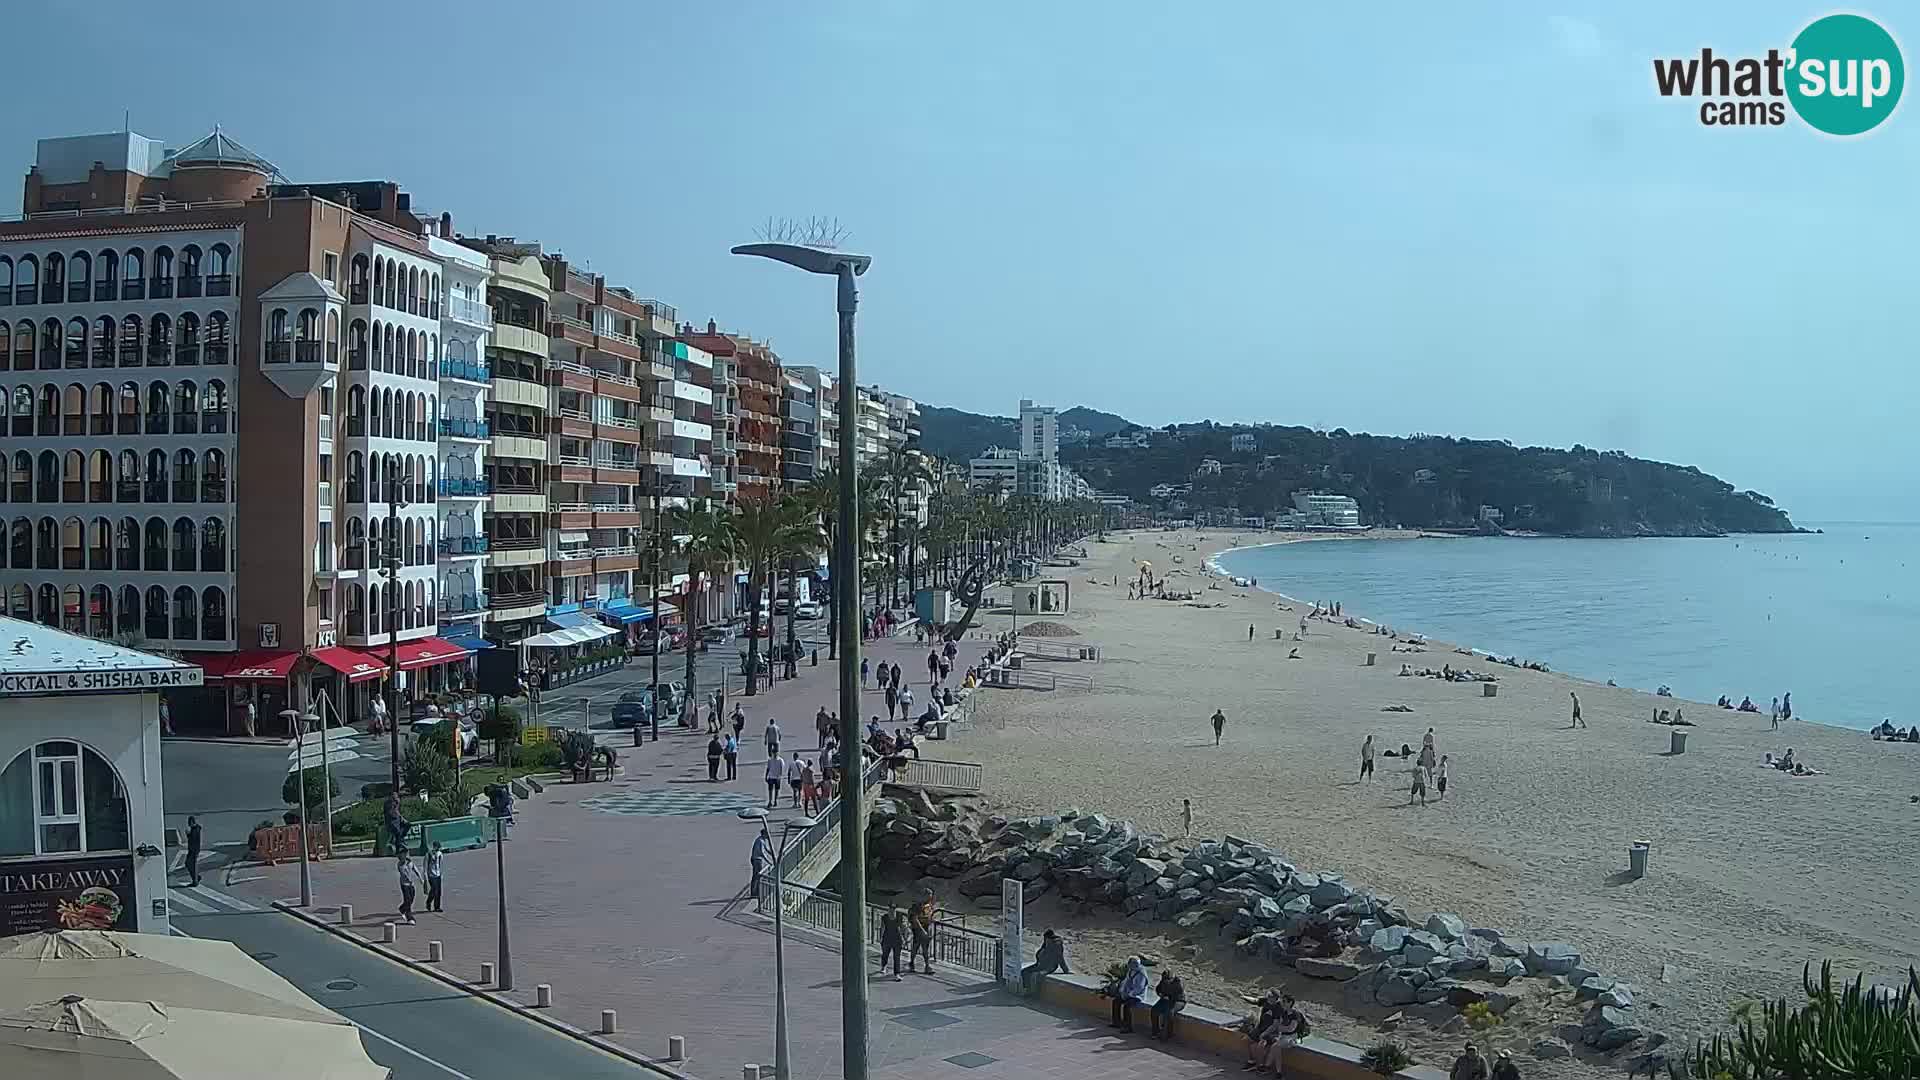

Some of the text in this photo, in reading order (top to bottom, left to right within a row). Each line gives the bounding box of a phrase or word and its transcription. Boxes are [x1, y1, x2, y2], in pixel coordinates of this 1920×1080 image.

[319, 630, 336, 647] KFC
[67, 677, 79, 689] &
[83, 672, 145, 687] SHISHA
[150, 671, 182, 686] BAR
[240, 668, 276, 676] KFC
[0, 868, 125, 893] TAKEAWAY
